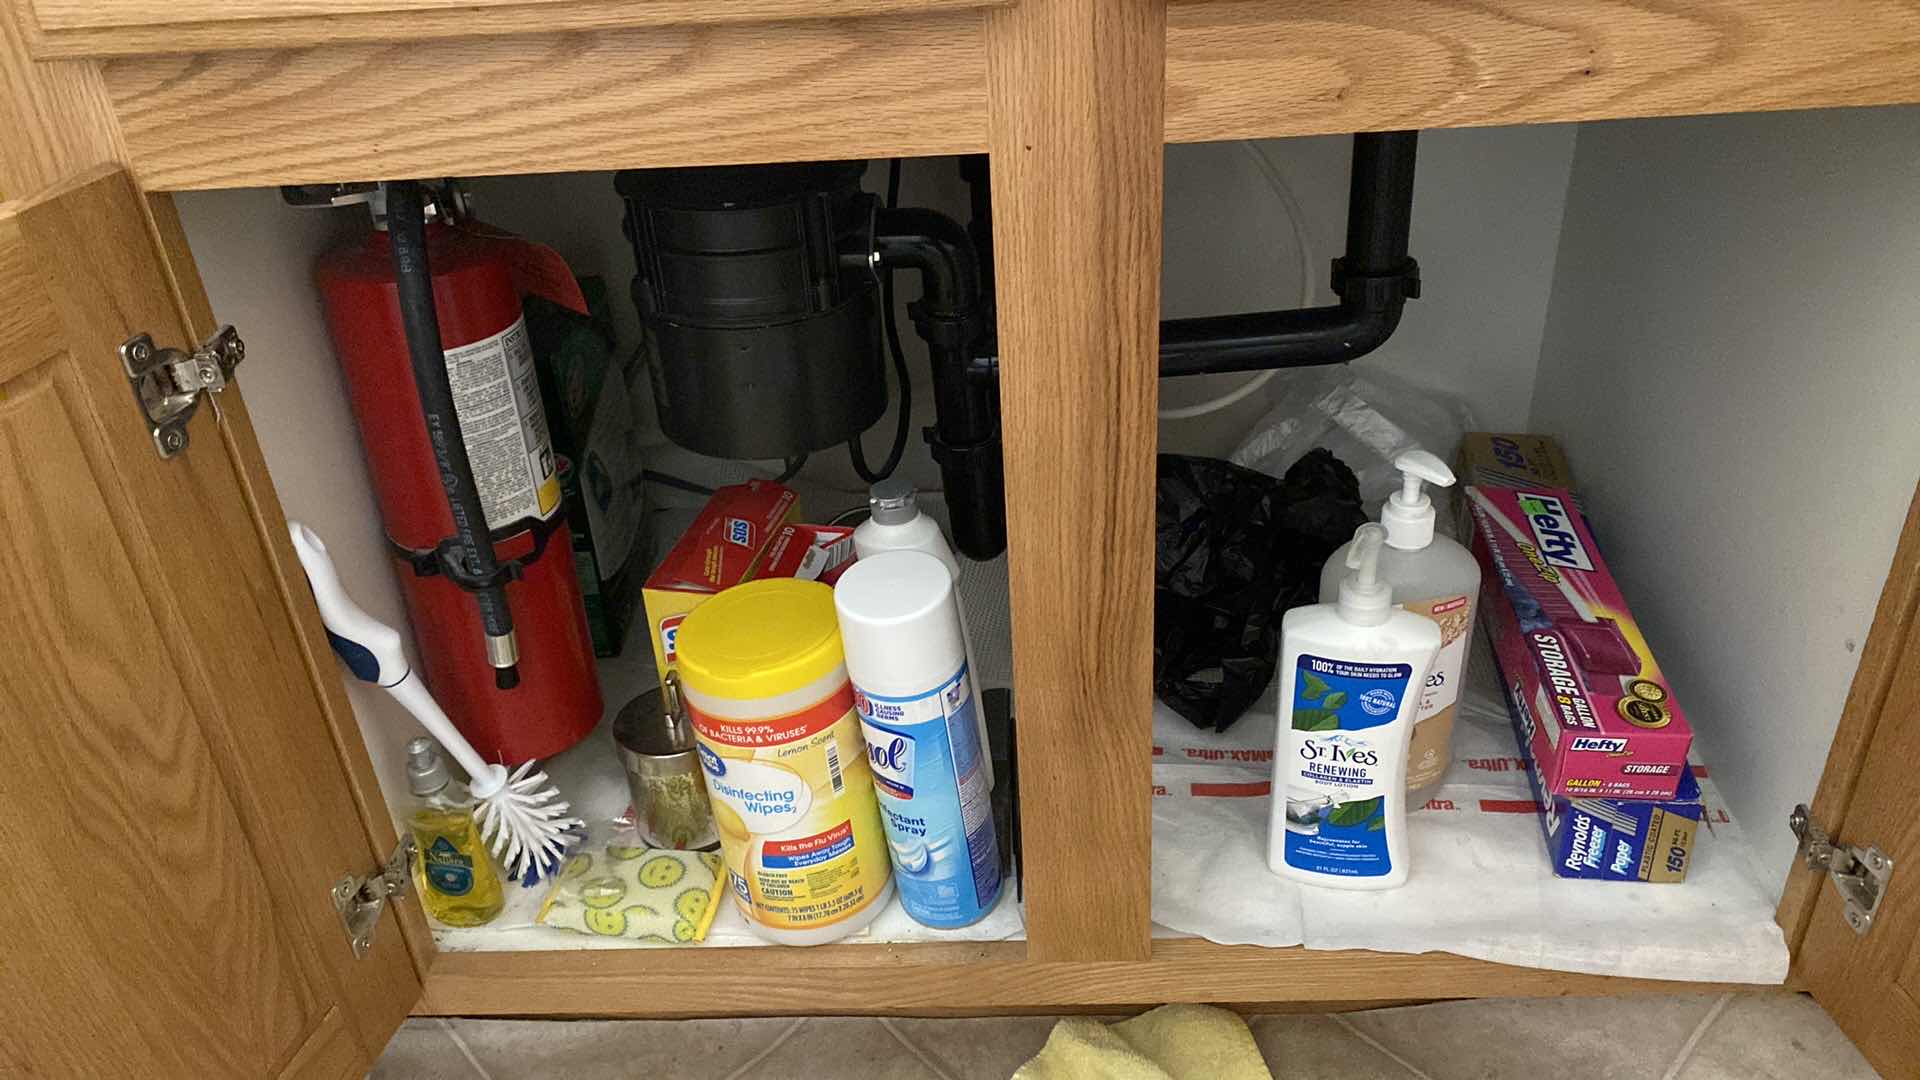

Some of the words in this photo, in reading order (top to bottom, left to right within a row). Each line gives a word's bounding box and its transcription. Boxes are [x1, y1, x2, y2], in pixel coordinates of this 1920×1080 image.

[783, 527, 795, 537] 10
[1525, 495, 1577, 566] Hefty
[1311, 659, 1334, 674] 100%
[1534, 633, 1581, 696] STORAGE
[1557, 695, 1570, 706] 8
[1559, 704, 1577, 726] BAGS
[1572, 697, 1597, 728] GALLON
[710, 729, 754, 744] BACTERIA
[755, 735, 763, 743] &
[720, 724, 743, 735] KILLS
[777, 744, 809, 758] Lemon
[810, 730, 836, 746] Scent
[1574, 739, 1623, 751] Hefty
[1309, 762, 1367, 778] RENEWING
[1624, 764, 1670, 774] STORAGE
[713, 779, 794, 802] Disinfecting
[1566, 779, 1601, 788] GALLON
[744, 801, 792, 816] Wipes
[890, 818, 927, 837] Spray
[780, 842, 798, 852] Kills
[799, 840, 813, 850] the
[814, 836, 827, 847] Flu
[1565, 814, 1592, 872] Reynolds
[1582, 826, 1607, 869] Freezer
[788, 853, 811, 862] Wipes
[811, 847, 831, 859] Away
[1610, 838, 1634, 876] Paper
[1665, 846, 1687, 873] 150
[761, 887, 793, 897] CAUTION
